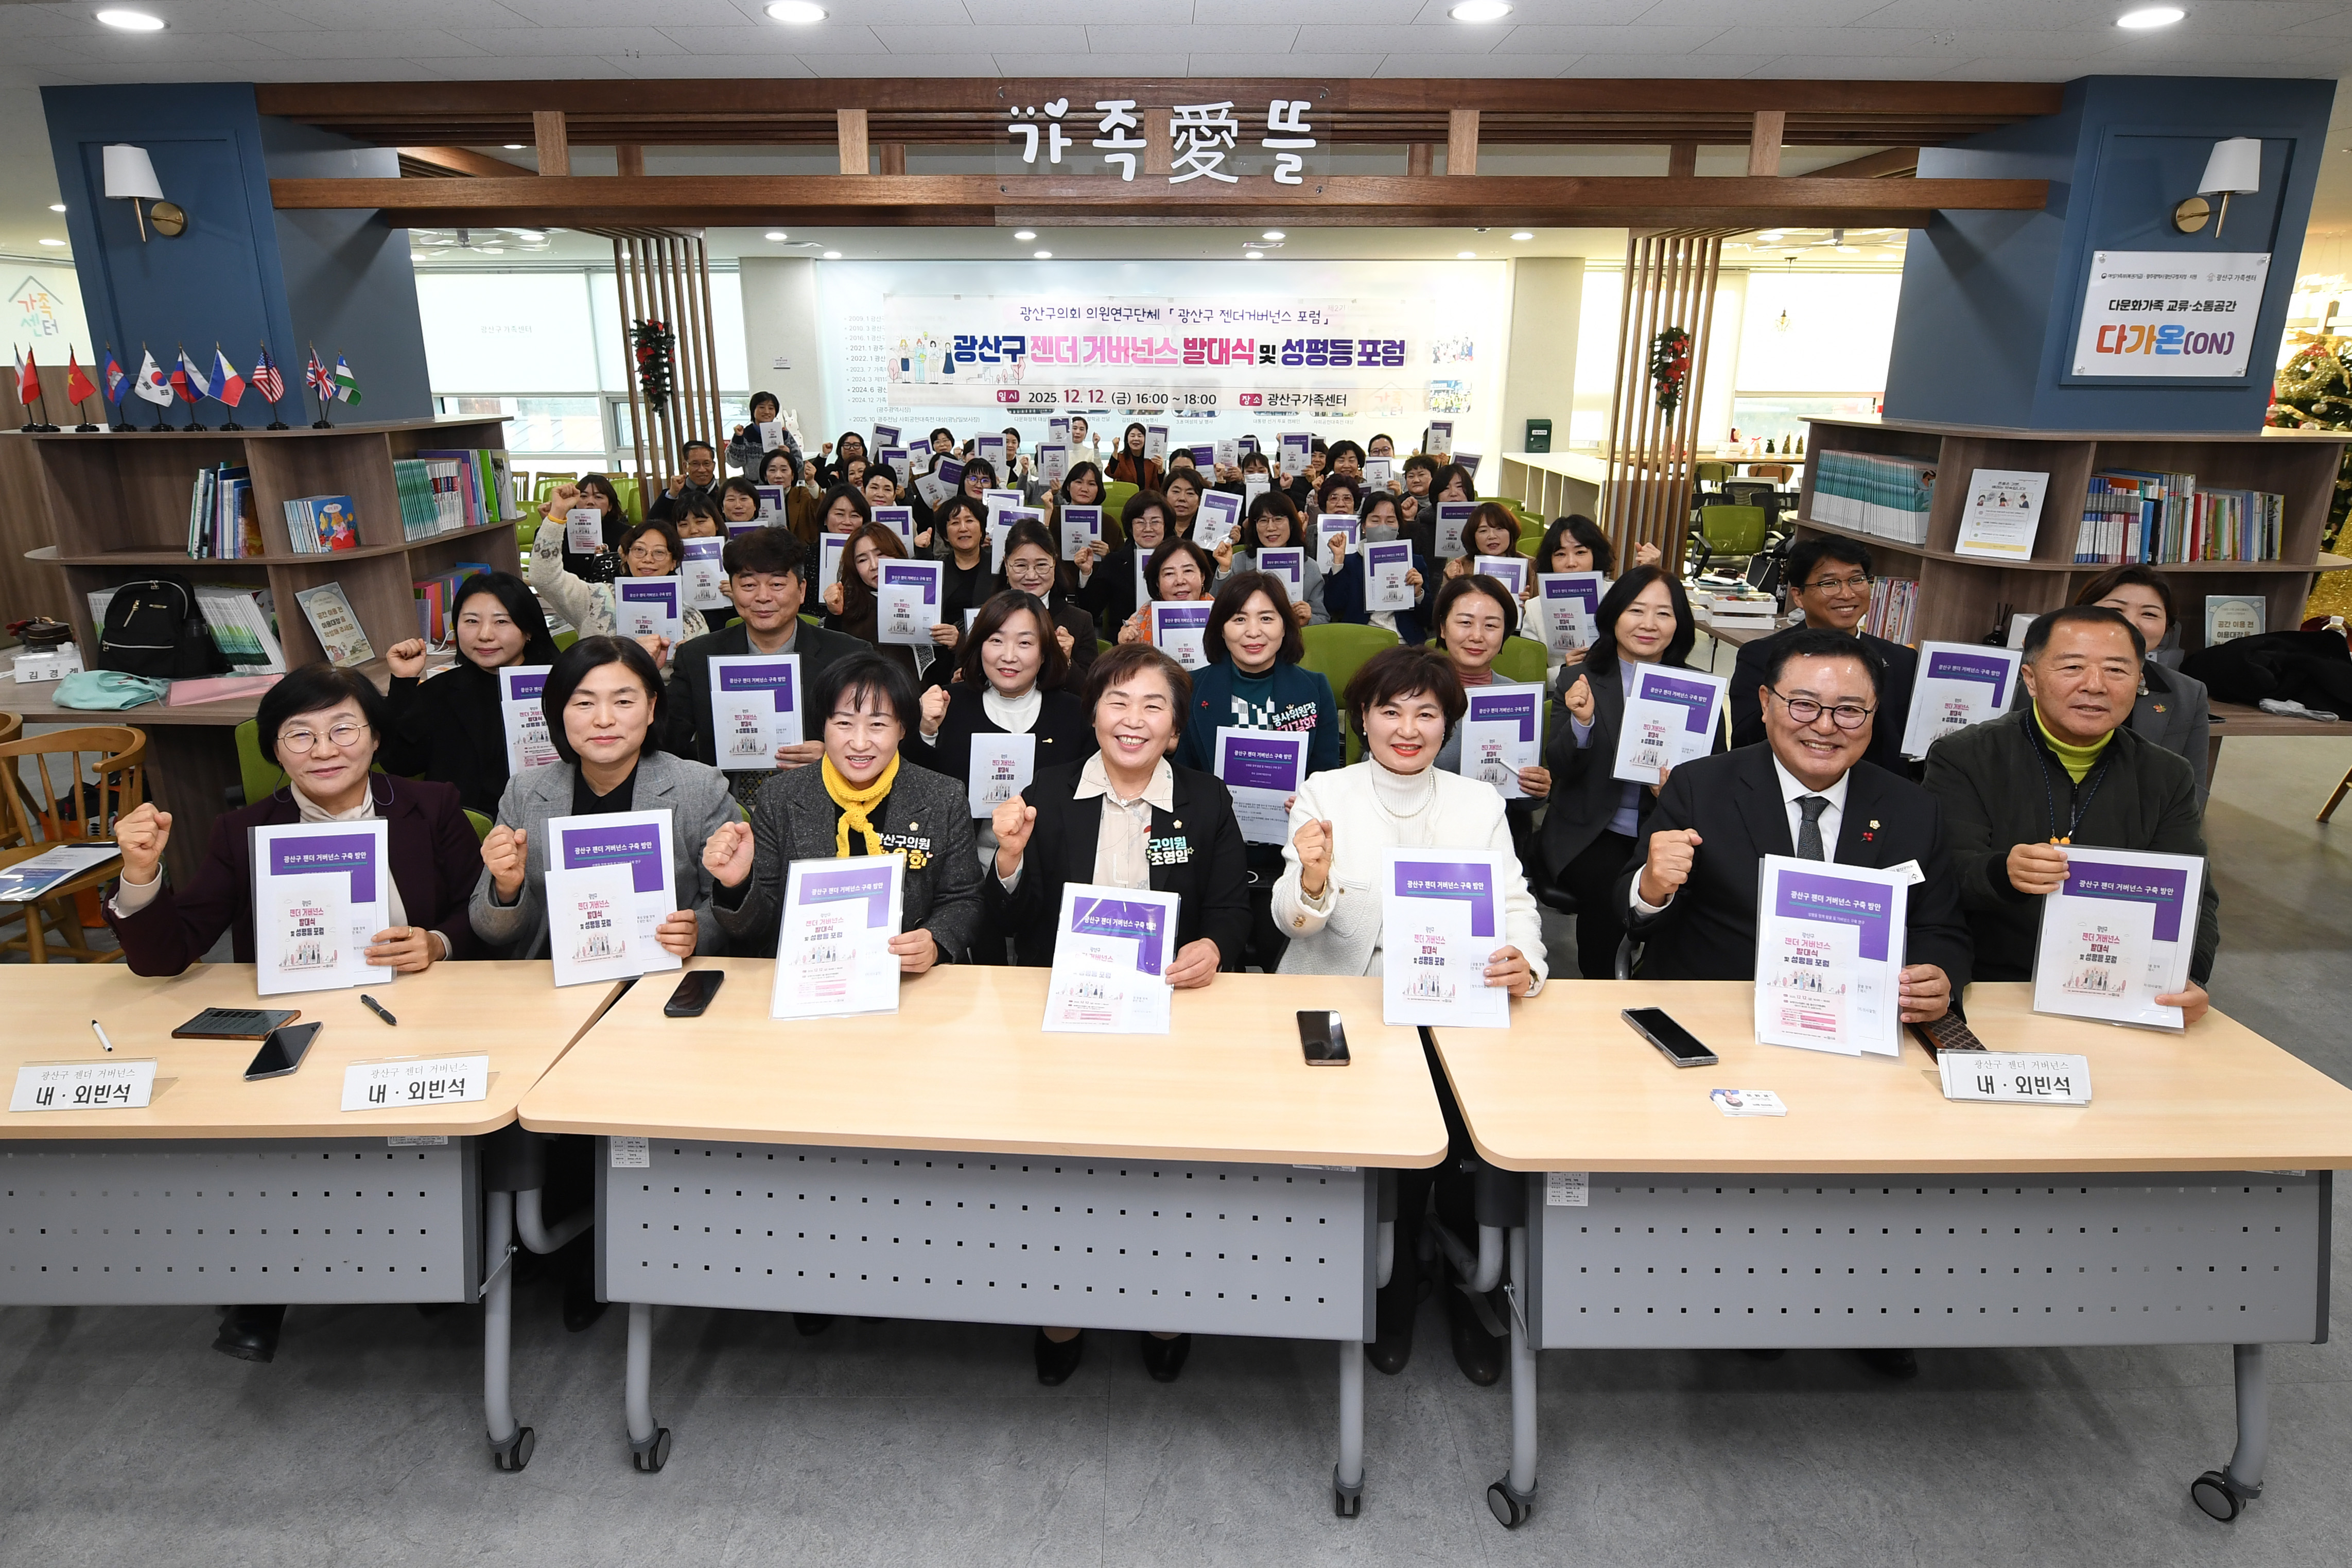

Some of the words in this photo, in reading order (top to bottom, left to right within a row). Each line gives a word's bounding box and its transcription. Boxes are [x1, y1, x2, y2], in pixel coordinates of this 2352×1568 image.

[2109, 299, 2164, 311] 다문화가족
[2166, 300, 2237, 312] 교류·소통공간
[1020, 307, 1081, 321] 광산구의회
[1086, 307, 1160, 322] 의원연구단체
[1219, 309, 1292, 324] 젠더거버넌스
[2096, 324, 2235, 355] 다가온(ON)
[953, 335, 1026, 362] 광산구
[1030, 336, 1078, 363] 젠더
[1083, 336, 1178, 364] 거버넌스
[1183, 337, 1254, 365] 발대식
[1259, 344, 1276, 364] 및
[1281, 338, 1353, 366] 성평등
[1357, 339, 1405, 367] 포럼
[1028, 392, 1060, 403] 2025.
[1064, 389, 1083, 403] 12.
[1088, 389, 1107, 403] 12.
[1111, 392, 1131, 405] (금)
[1136, 393, 1169, 404] 16:00
[1184, 394, 1217, 405] 18:00
[1267, 393, 1347, 407] 광산구가족센터
[1271, 702, 1317, 727] 봉사위원장
[574, 847, 591, 855] 광산구
[604, 844, 627, 852] 거버넌스
[628, 843, 639, 851] 구축
[1148, 836, 1187, 852] 구의원
[284, 855, 301, 864] 광산구
[303, 854, 315, 862] 젠더
[316, 853, 340, 862] 거버넌스
[1151, 849, 1189, 866] 조영임
[1407, 880, 1423, 889] 광산구
[1424, 881, 1436, 889] 젠더
[1437, 881, 1459, 890] 거버넌스
[1460, 882, 1472, 890] 구축
[1473, 882, 1484, 891] 방안
[2079, 880, 2099, 888] 광산구
[2116, 883, 2143, 893] 거버넌스
[2145, 886, 2158, 894] 구축
[2160, 887, 2174, 896] 방안
[1790, 891, 1810, 900] 광산구
[1811, 893, 1824, 903] 젠더
[1825, 895, 1852, 907] 거버넌스
[1853, 899, 1866, 910] 구축
[1868, 901, 1881, 912] 방안
[1801, 938, 1831, 950] 거버넌스
[371, 1068, 399, 1079] 광산구
[405, 1066, 424, 1076] 젠더
[429, 1062, 468, 1074] 거버넌스
[1974, 1059, 2002, 1070] 광산구
[2008, 1060, 2026, 1070] 젠더
[2031, 1060, 2069, 1071] 거버넌스
[41, 1071, 69, 1081] 광산구
[74, 1070, 93, 1080] 젠더
[97, 1069, 135, 1079] 거버넌스
[369, 1084, 387, 1104] 내
[407, 1077, 465, 1100] 외빈석
[1977, 1075, 1995, 1094] 내
[2015, 1075, 2071, 1096] 외빈석
[36, 1086, 55, 1106] 내
[73, 1084, 131, 1104] 외빈석
